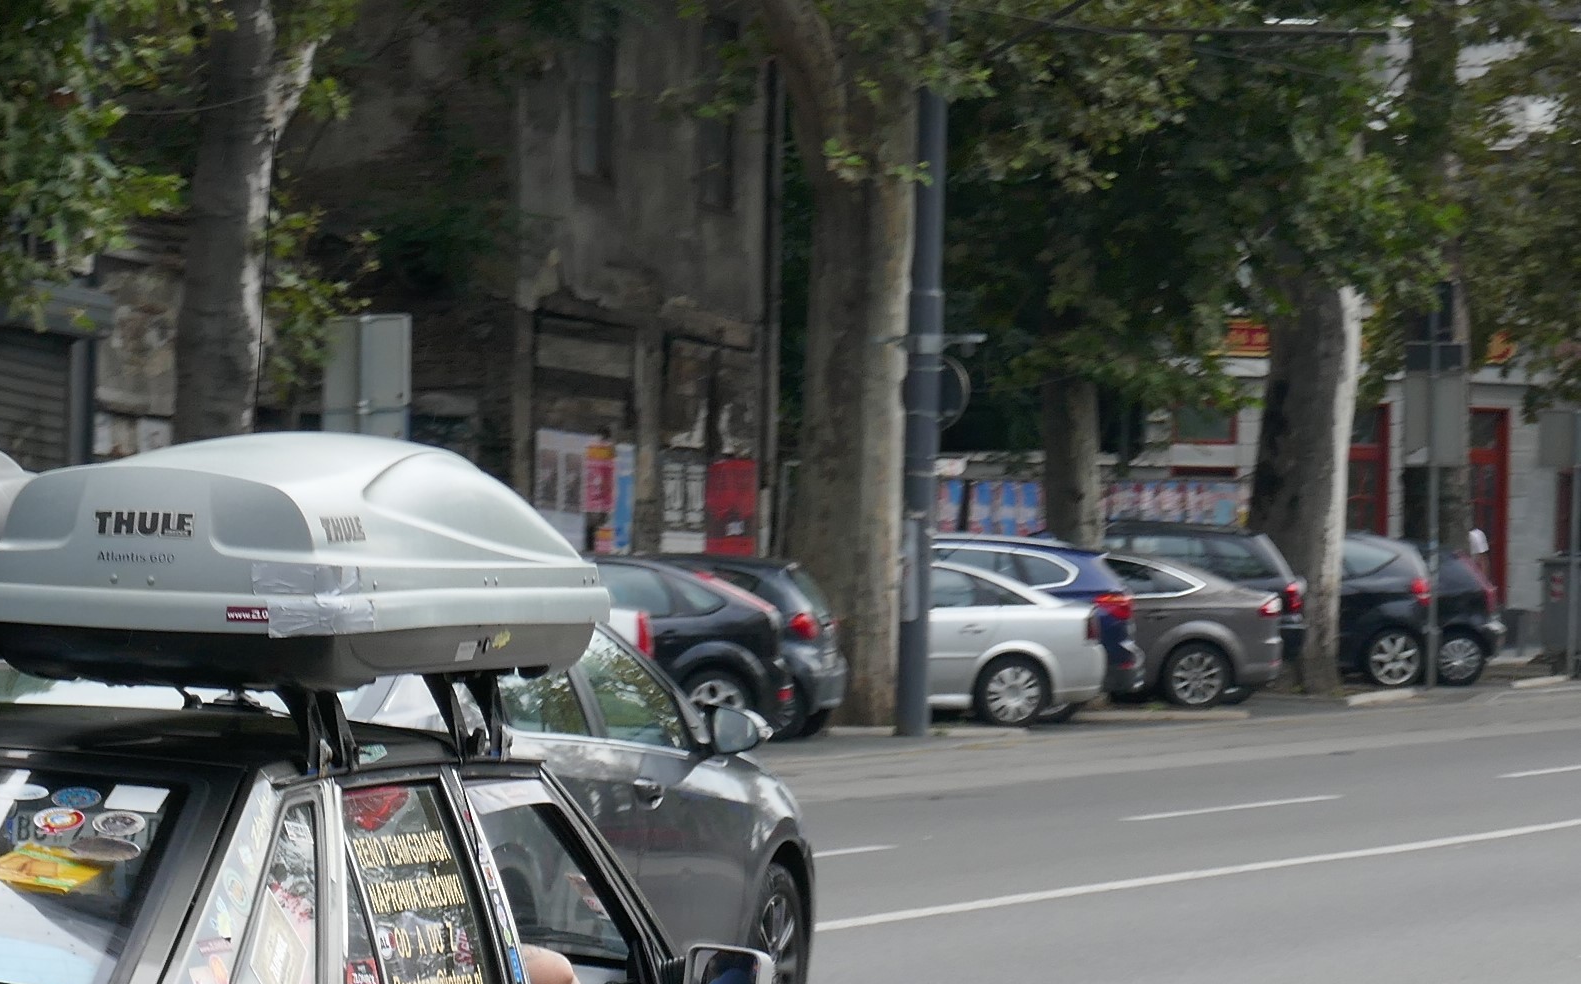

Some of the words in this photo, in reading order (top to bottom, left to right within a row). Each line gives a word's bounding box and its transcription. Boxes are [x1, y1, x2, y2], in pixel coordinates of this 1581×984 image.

[95, 510, 194, 537] THULE
[319, 515, 366, 543] THULE
[97, 550, 144, 564] Atlantis
[149, 553, 175, 565] 600
